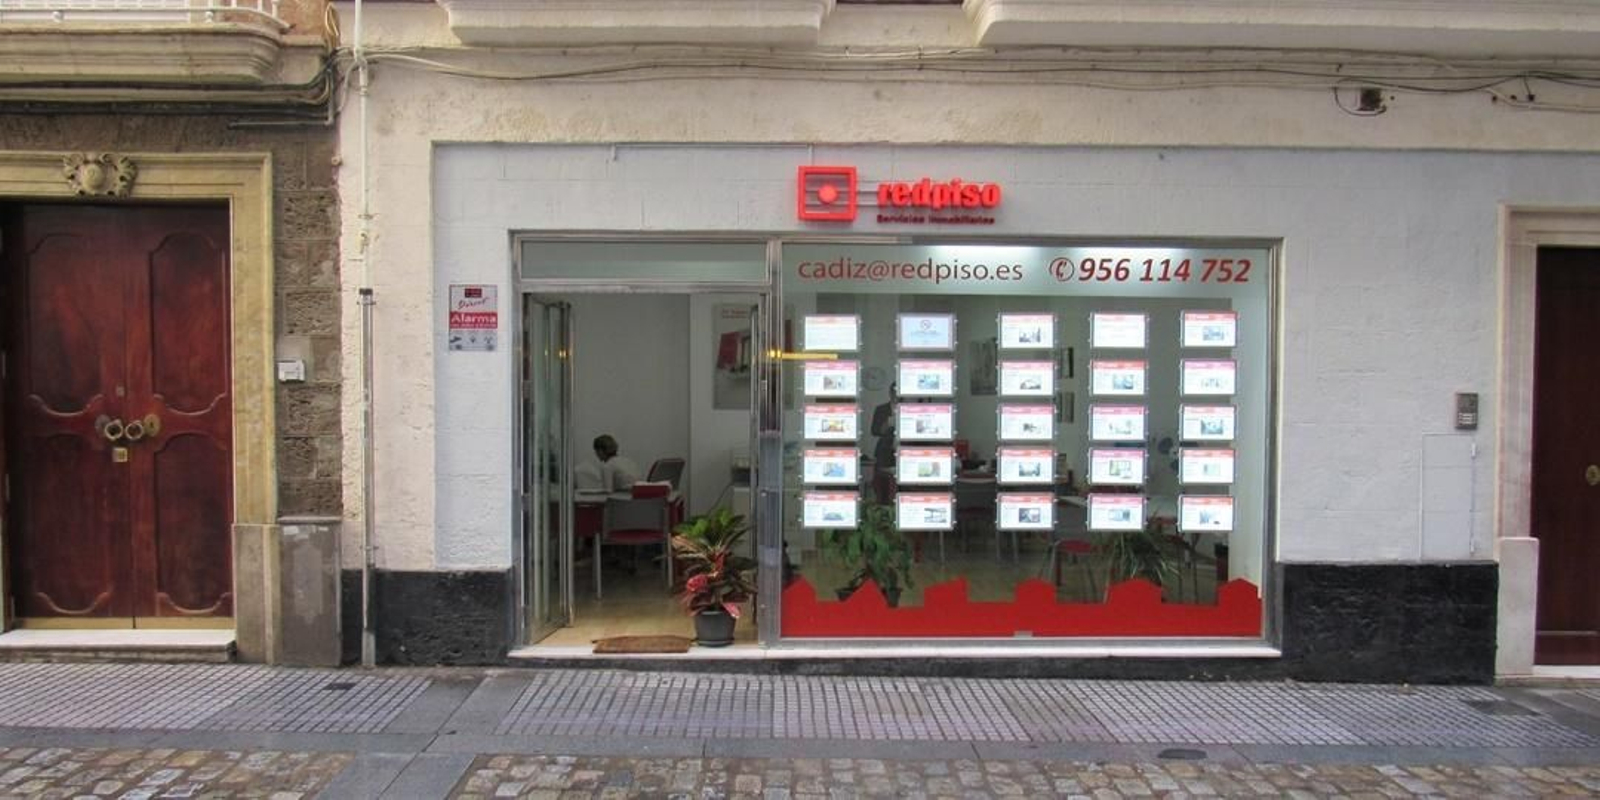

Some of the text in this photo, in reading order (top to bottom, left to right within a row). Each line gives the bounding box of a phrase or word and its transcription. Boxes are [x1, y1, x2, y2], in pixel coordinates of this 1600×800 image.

[877, 178, 1001, 210] redpiso
[798, 257, 1023, 285] cadiz@redpiso.es
[1078, 257, 1252, 283] 956 114 752
[451, 312, 497, 324] Alarma
